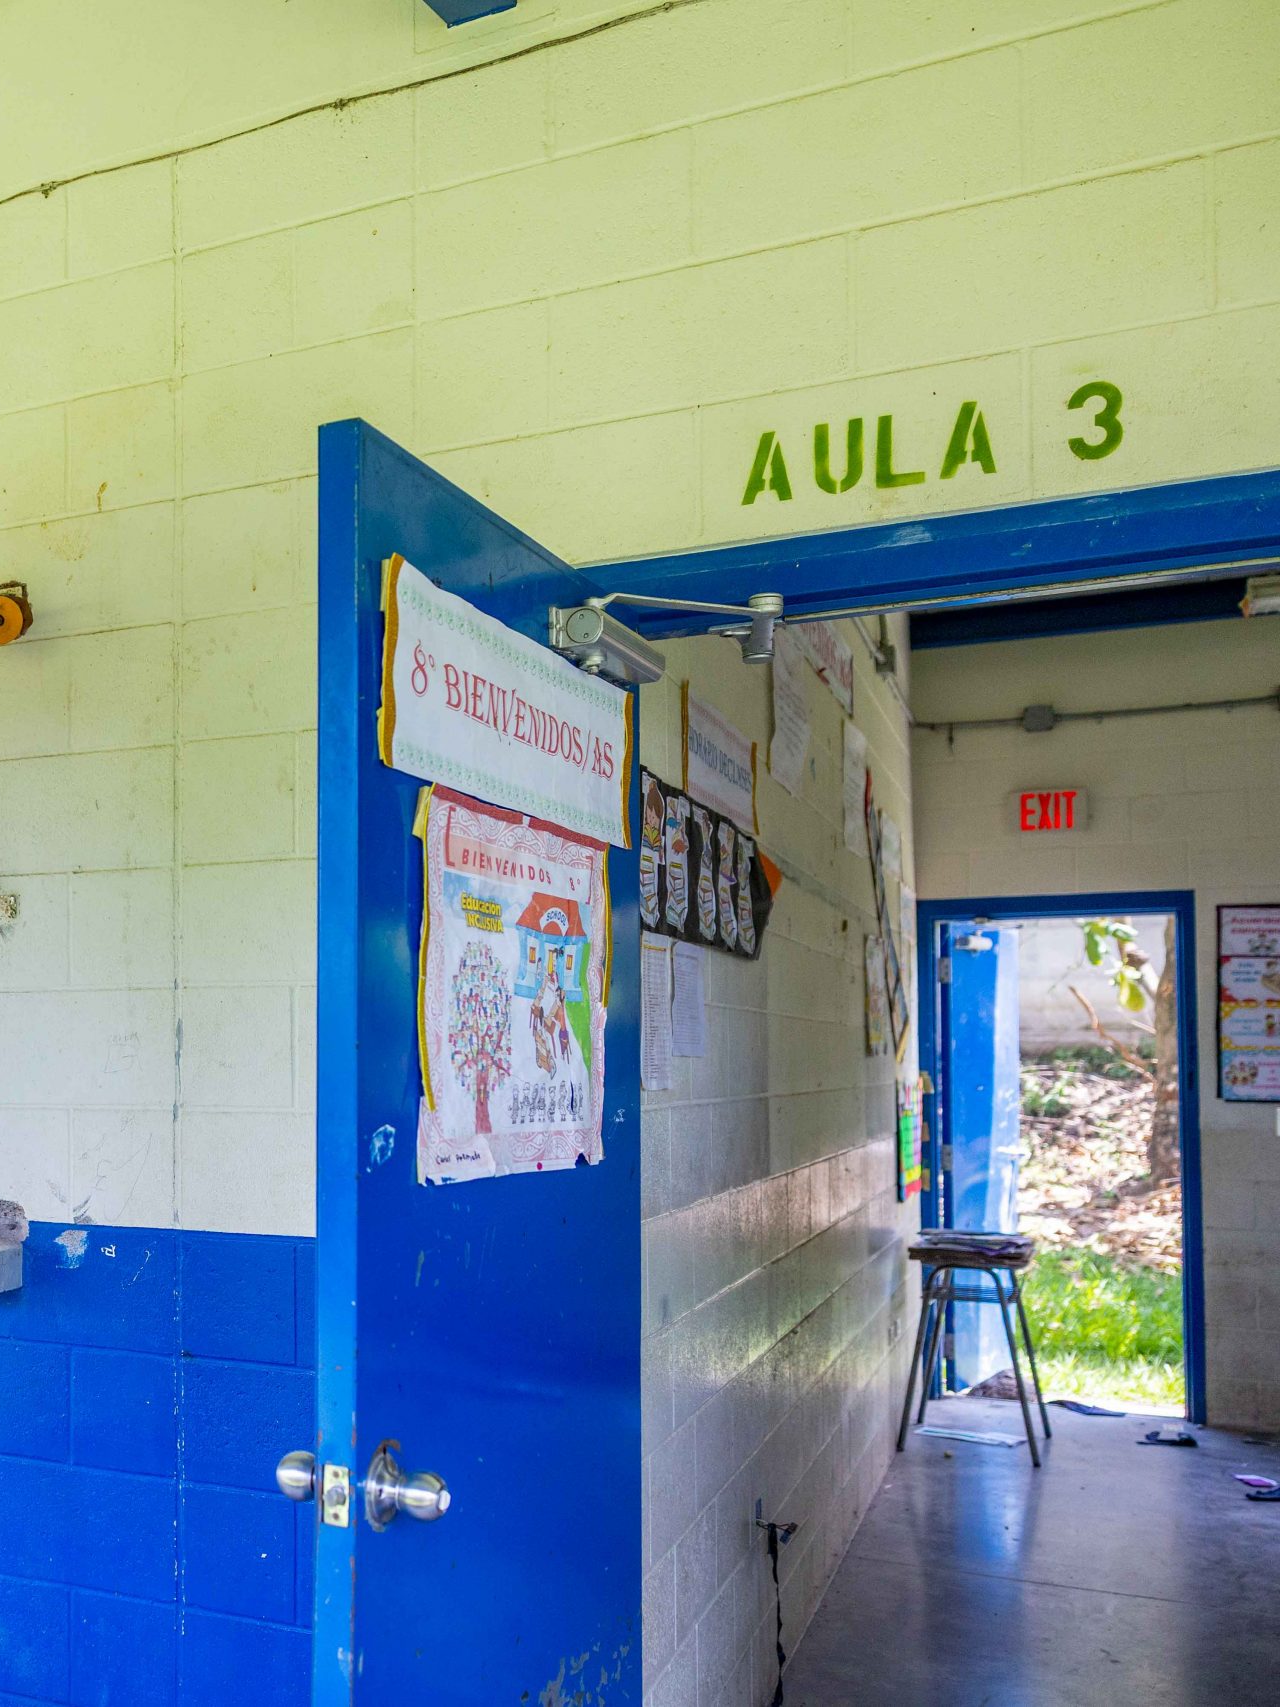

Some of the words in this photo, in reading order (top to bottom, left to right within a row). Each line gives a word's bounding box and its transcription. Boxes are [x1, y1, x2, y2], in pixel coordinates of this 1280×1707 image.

[741, 400, 997, 506] AULA
[1067, 380, 1124, 460] 3
[444, 663, 615, 781] BIENVENIDOS/AS
[1020, 791, 1078, 831] EXIT
[462, 848, 552, 884] BIENVENIDOS
[546, 909, 566, 926] SCHOOL
